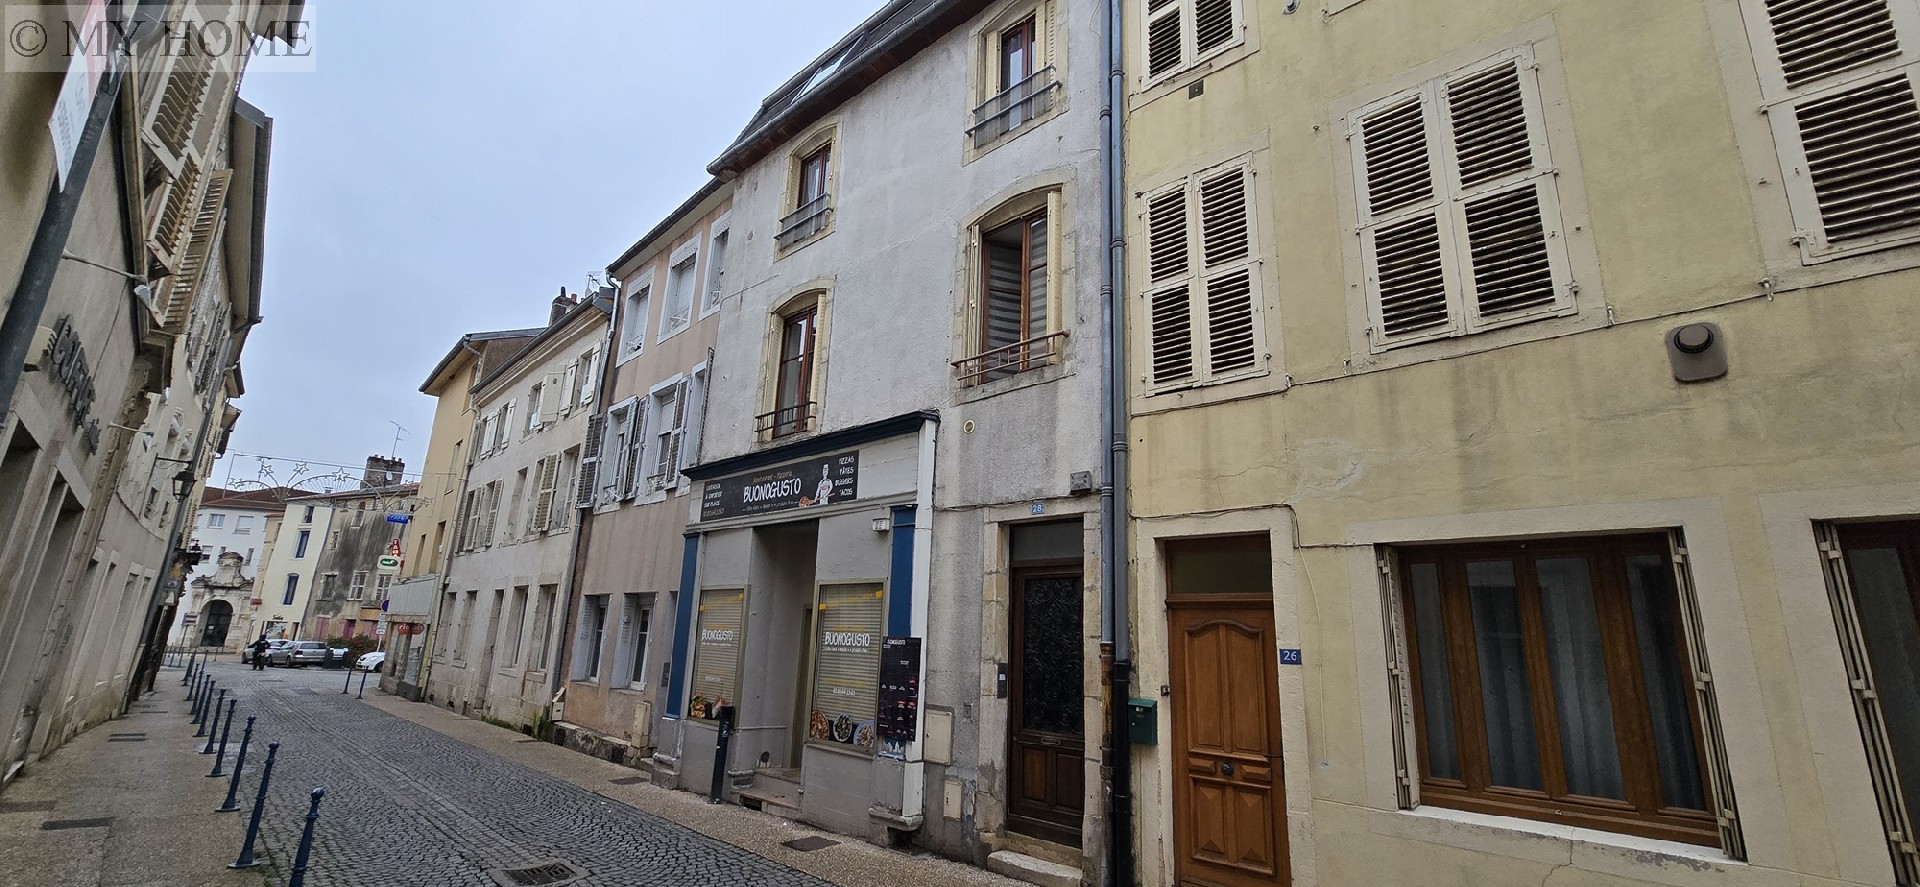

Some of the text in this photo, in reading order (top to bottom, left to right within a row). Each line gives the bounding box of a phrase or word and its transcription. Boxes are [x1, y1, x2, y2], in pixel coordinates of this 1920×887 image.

[743, 477, 802, 503] BUONOGUSTO
[1032, 504, 1042, 513] 28
[824, 631, 871, 647] BUONOGUSTO
[1283, 650, 1297, 661] 26
